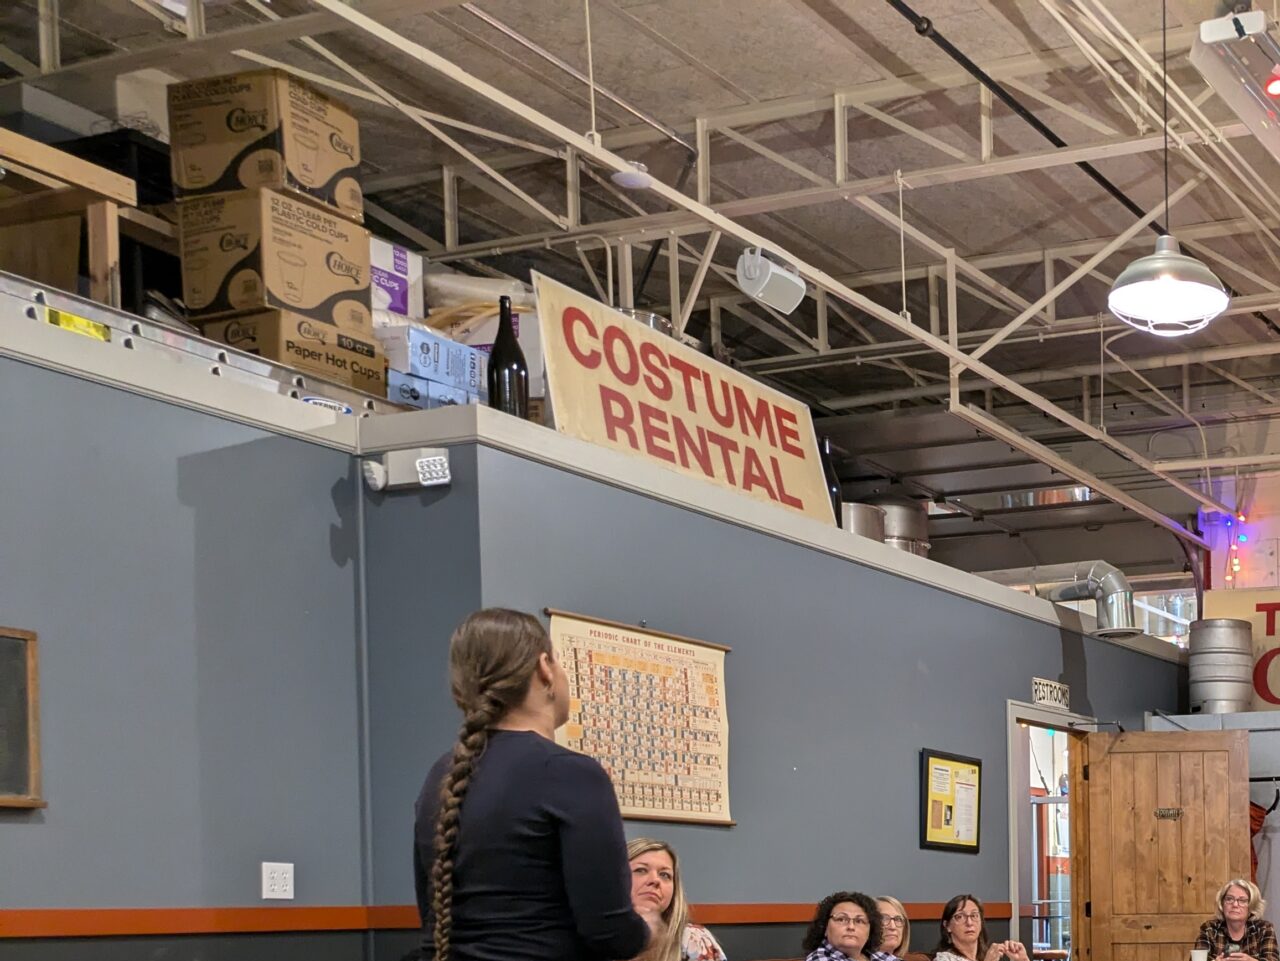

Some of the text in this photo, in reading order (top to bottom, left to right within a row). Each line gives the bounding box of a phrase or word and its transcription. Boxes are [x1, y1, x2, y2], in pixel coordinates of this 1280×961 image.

[271, 206, 305, 225] PLASTIC
[306, 219, 328, 233] COLD
[328, 228, 349, 243] CUPS
[297, 207, 322, 222] CLEAR
[323, 216, 337, 229] PET
[326, 250, 363, 285] CHOICE
[380, 277, 400, 290] CUPS
[340, 337, 353, 348] 10
[285, 339, 323, 362] Paper
[325, 353, 348, 370] Hot
[350, 361, 381, 381] Cups
[562, 306, 805, 460] COSTUME
[598, 384, 804, 510] RENTAL
[589, 629, 696, 657] PERIODIC CHART OF THE ELEMENTS
[1034, 682, 1070, 708] RESTROOMS
